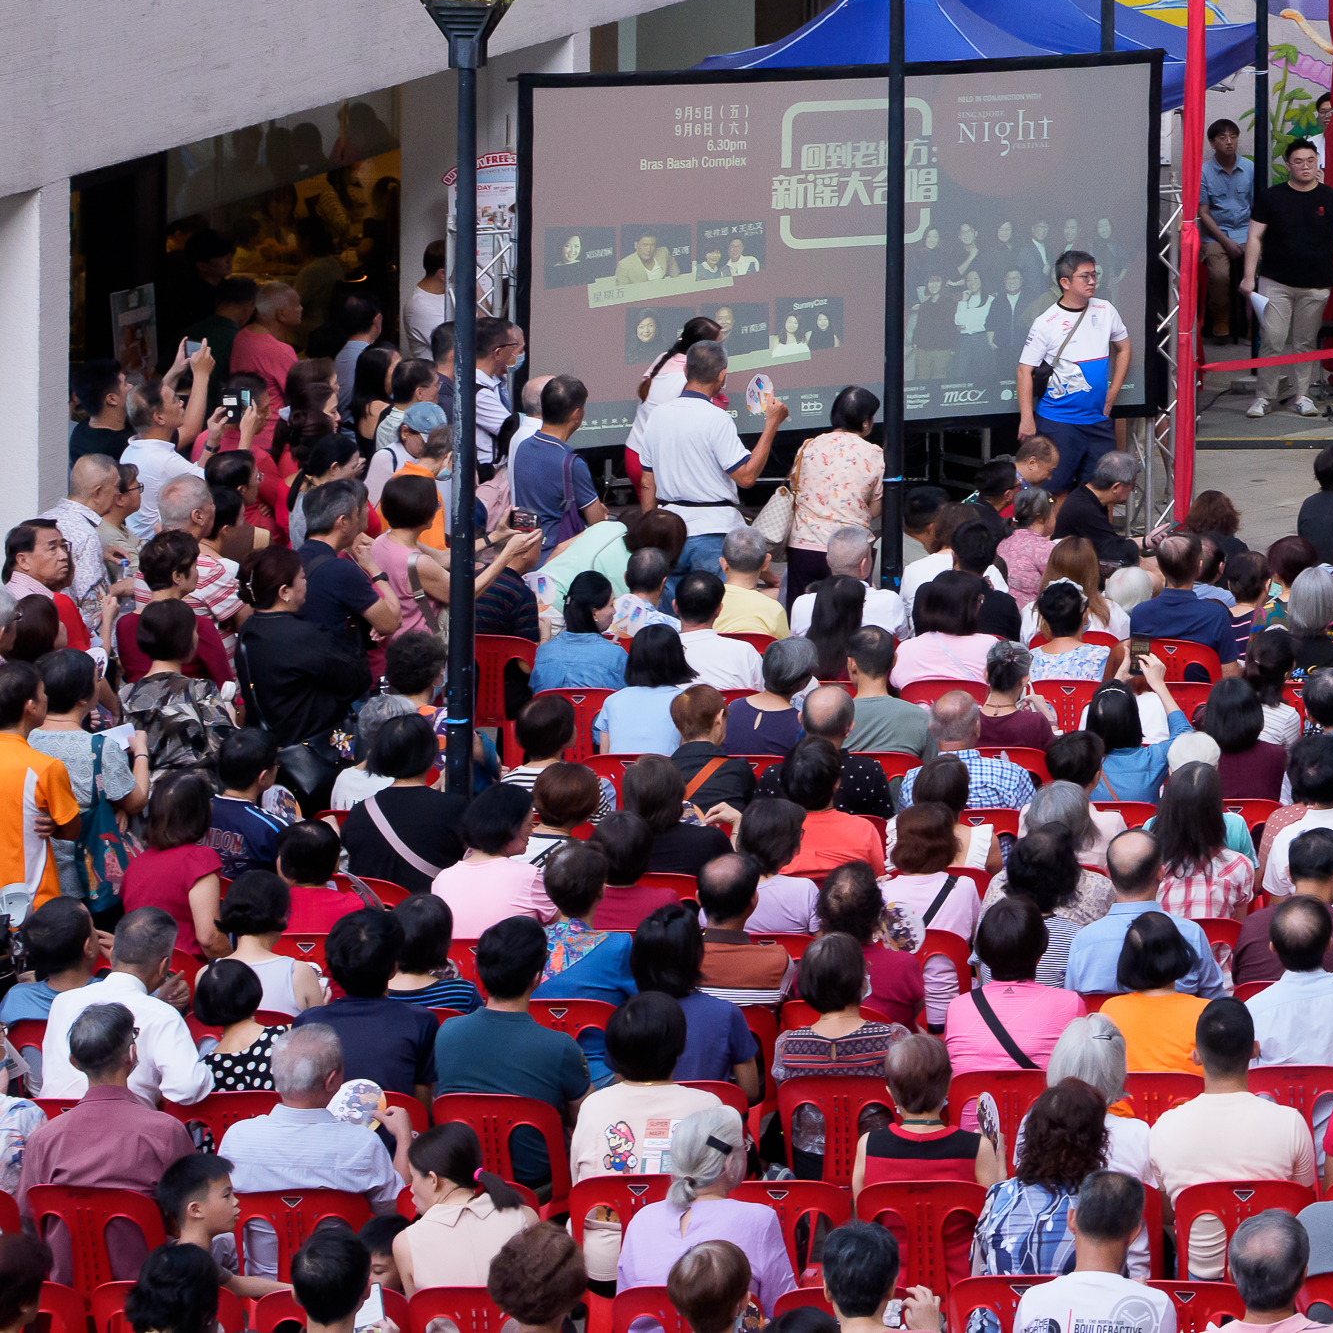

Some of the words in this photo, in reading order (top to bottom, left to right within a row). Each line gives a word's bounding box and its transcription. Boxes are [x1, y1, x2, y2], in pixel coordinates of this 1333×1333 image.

[707, 139, 747, 152] 6.30pm
[486, 153, 509, 164] FREE
[639, 158, 663, 172] Bras
[667, 157, 698, 170] Basah
[701, 155, 747, 169] Complex
